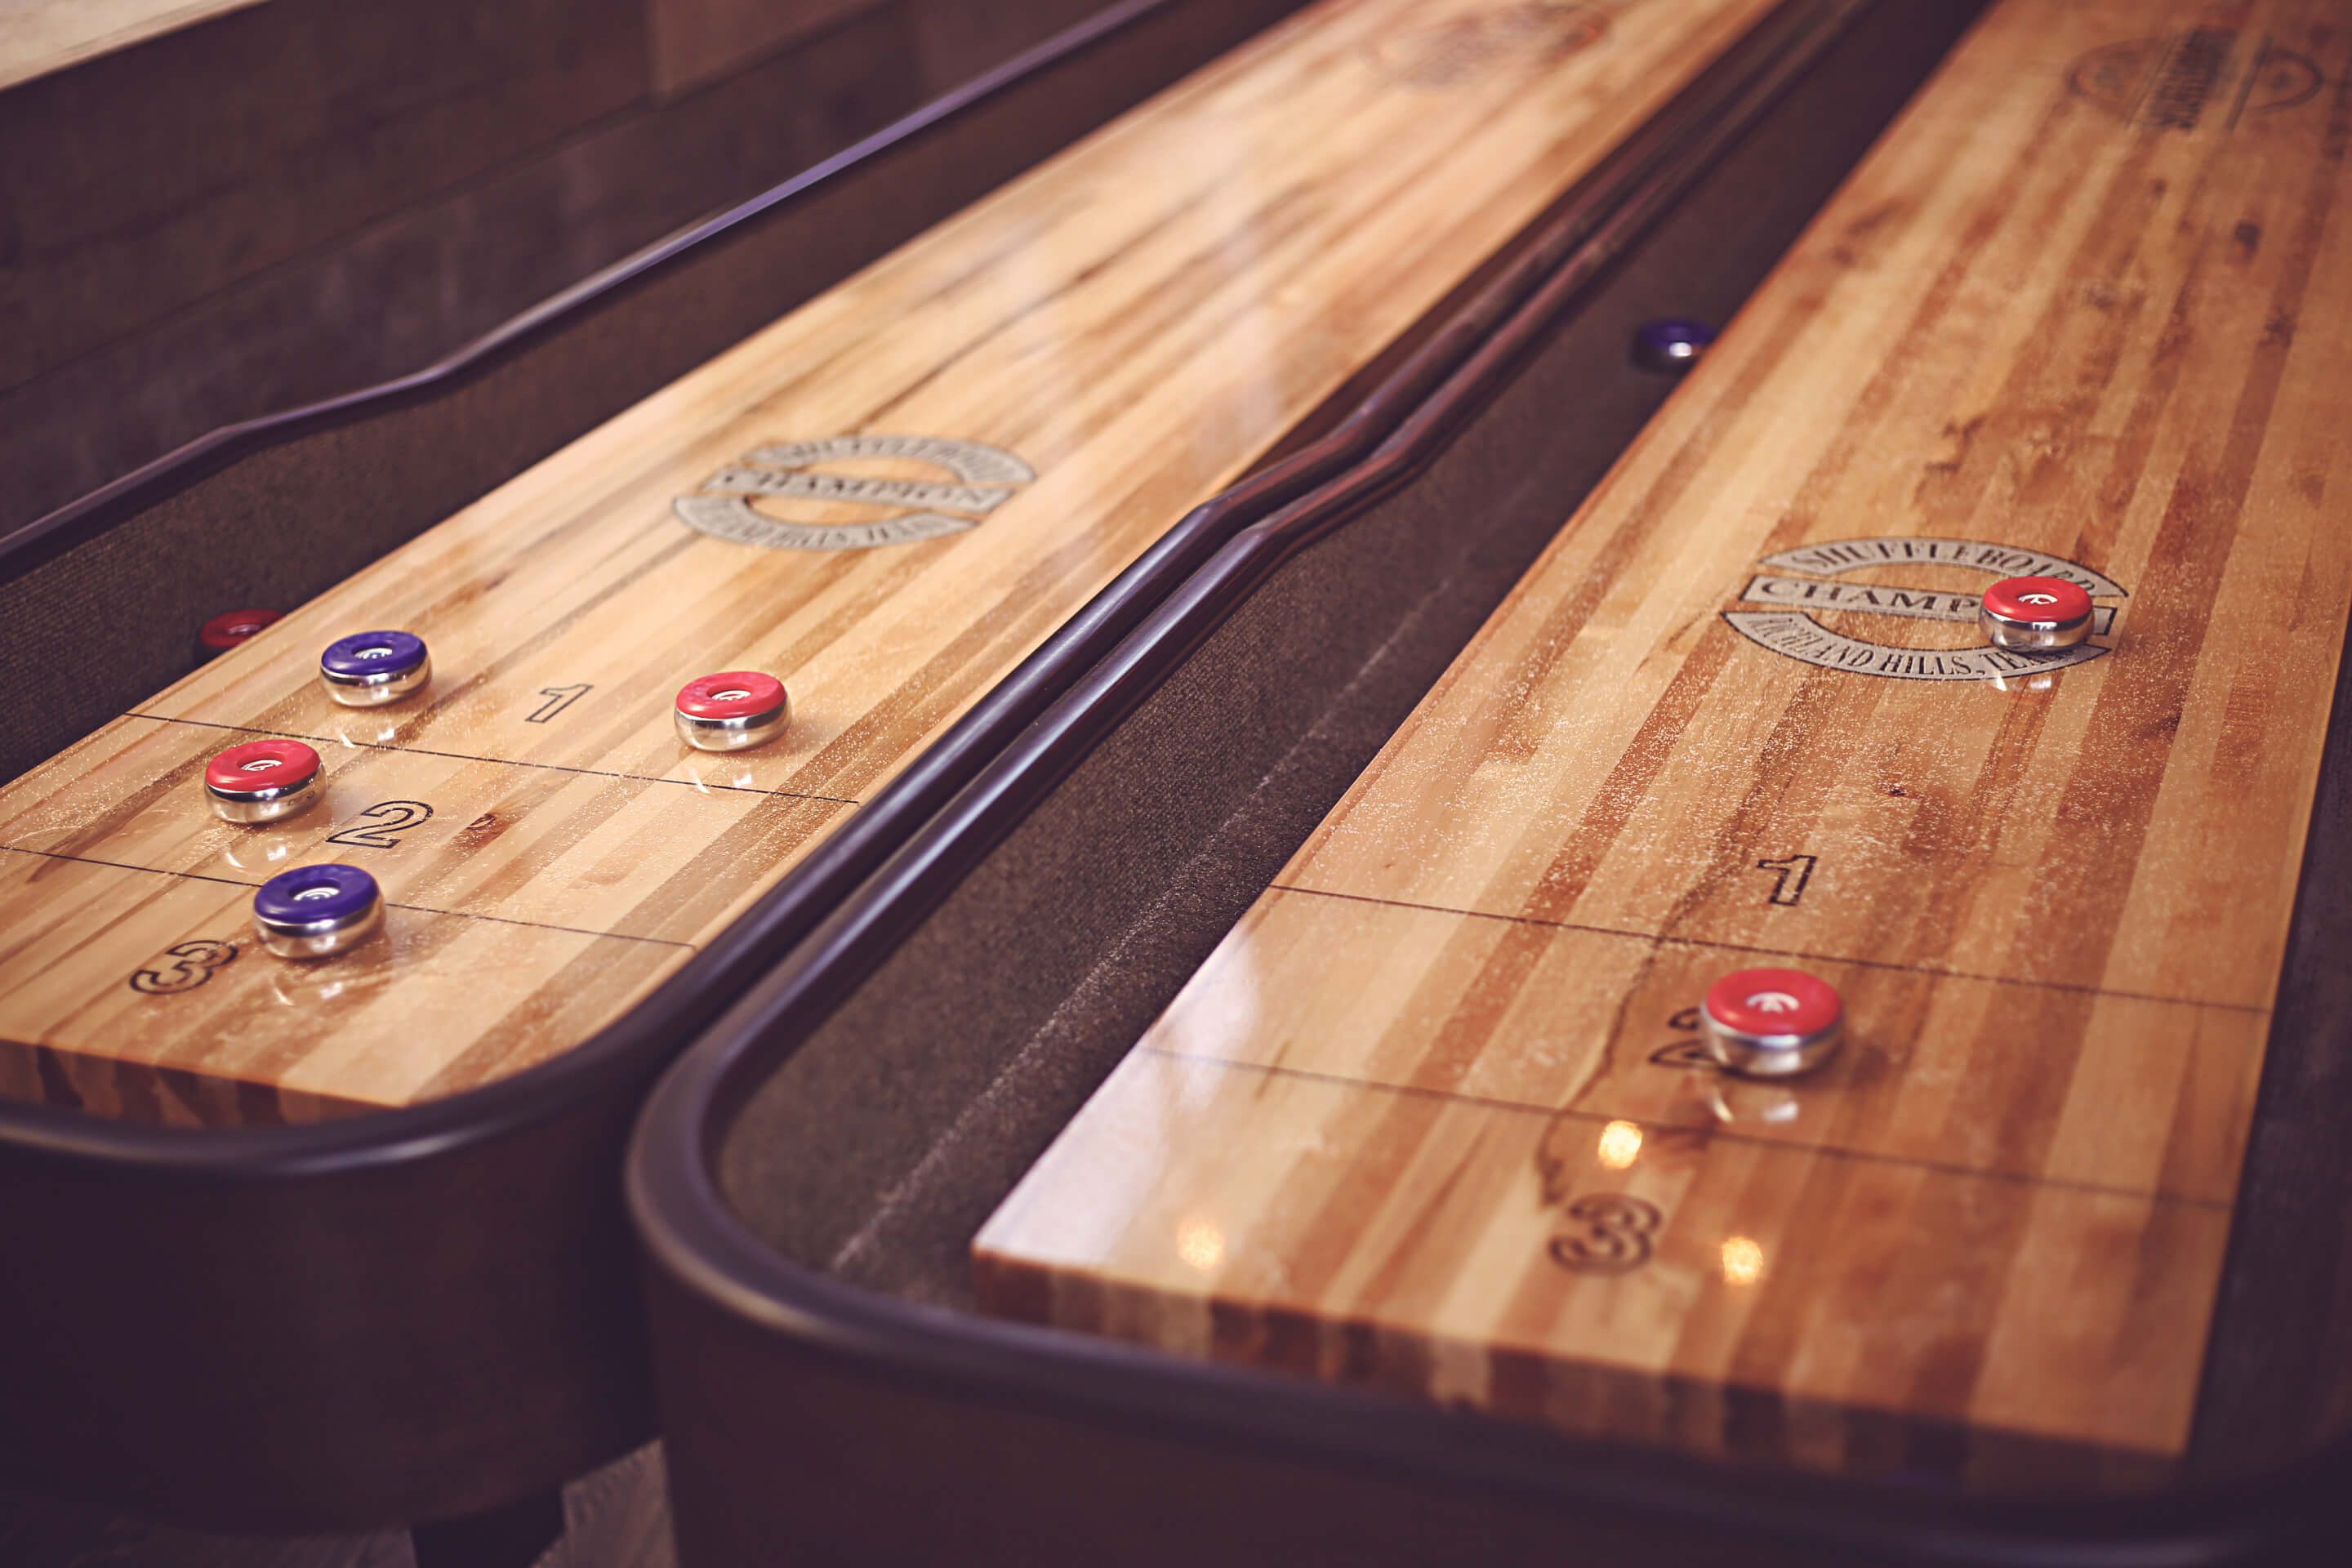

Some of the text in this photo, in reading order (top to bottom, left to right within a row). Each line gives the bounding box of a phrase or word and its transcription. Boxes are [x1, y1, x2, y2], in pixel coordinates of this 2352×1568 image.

[1878, 651, 1986, 675] HILLS,
[523, 683, 595, 724] 1
[325, 800, 434, 849] 2
[1756, 854, 1818, 906] 1
[128, 939, 239, 995] 3
[1547, 1191, 1661, 1276] 3
